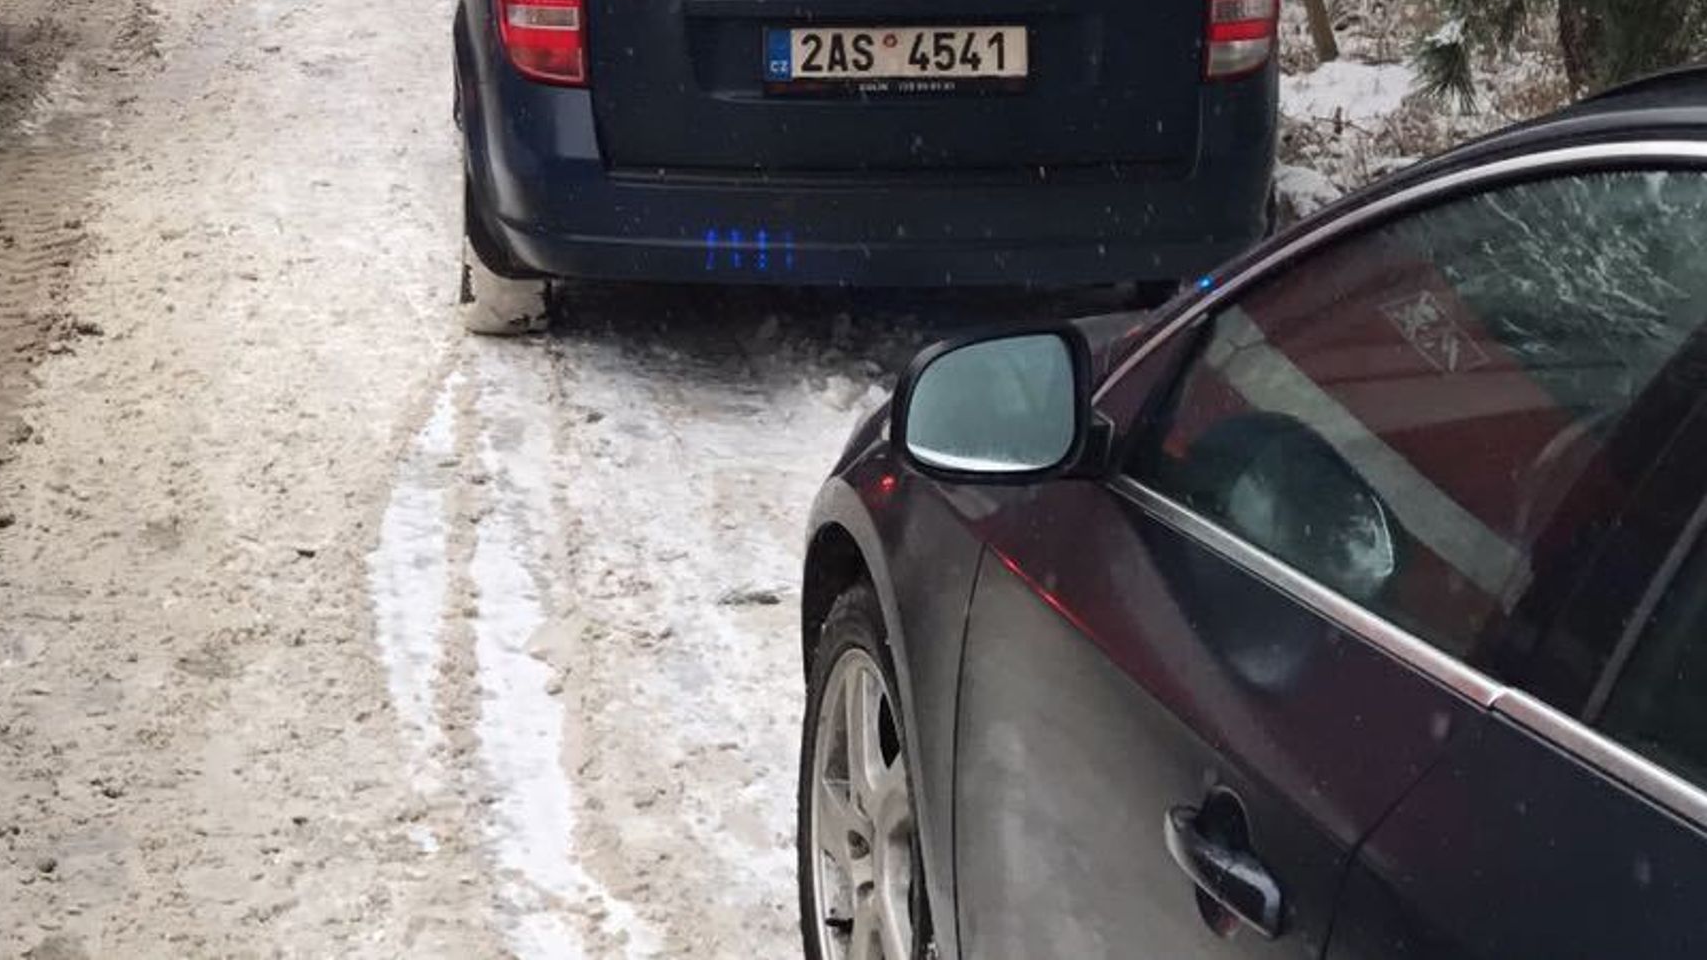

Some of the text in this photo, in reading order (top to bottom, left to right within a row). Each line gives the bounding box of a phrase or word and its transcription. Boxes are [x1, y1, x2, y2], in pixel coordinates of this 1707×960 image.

[800, 32, 1006, 73] 2AS 4541
[769, 61, 789, 73] CZ
